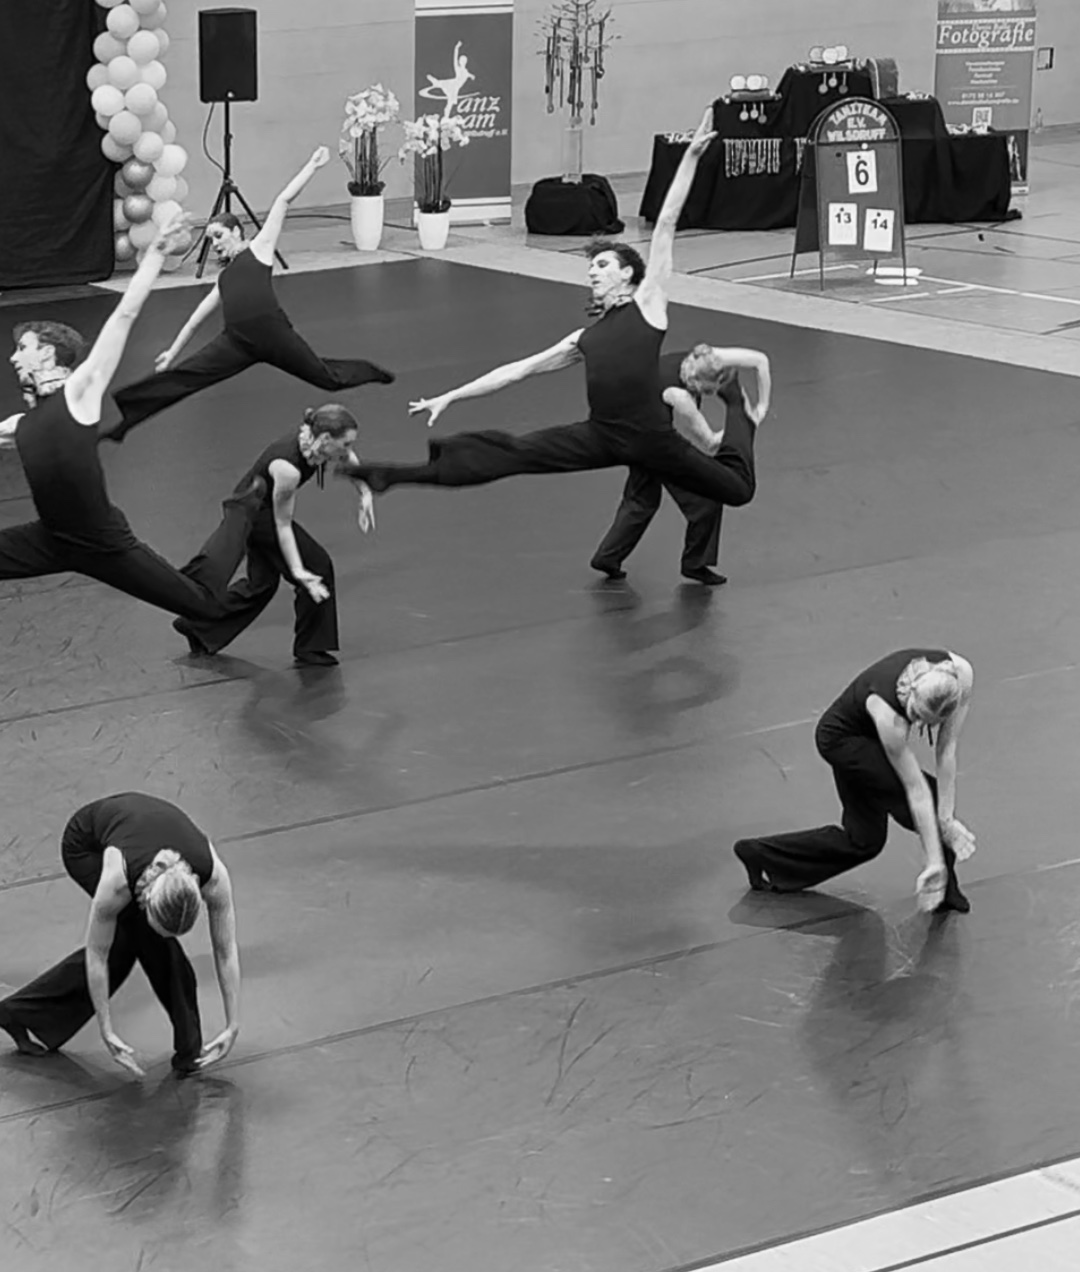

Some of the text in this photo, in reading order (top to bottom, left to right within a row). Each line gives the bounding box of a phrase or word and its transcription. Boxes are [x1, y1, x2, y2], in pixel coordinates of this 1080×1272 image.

[937, 20, 1035, 49] Fotografie
[826, 127, 886, 142] WILSDRUFF
[855, 159, 870, 186] 6
[834, 212, 852, 224] 13
[871, 218, 889, 230] 14
